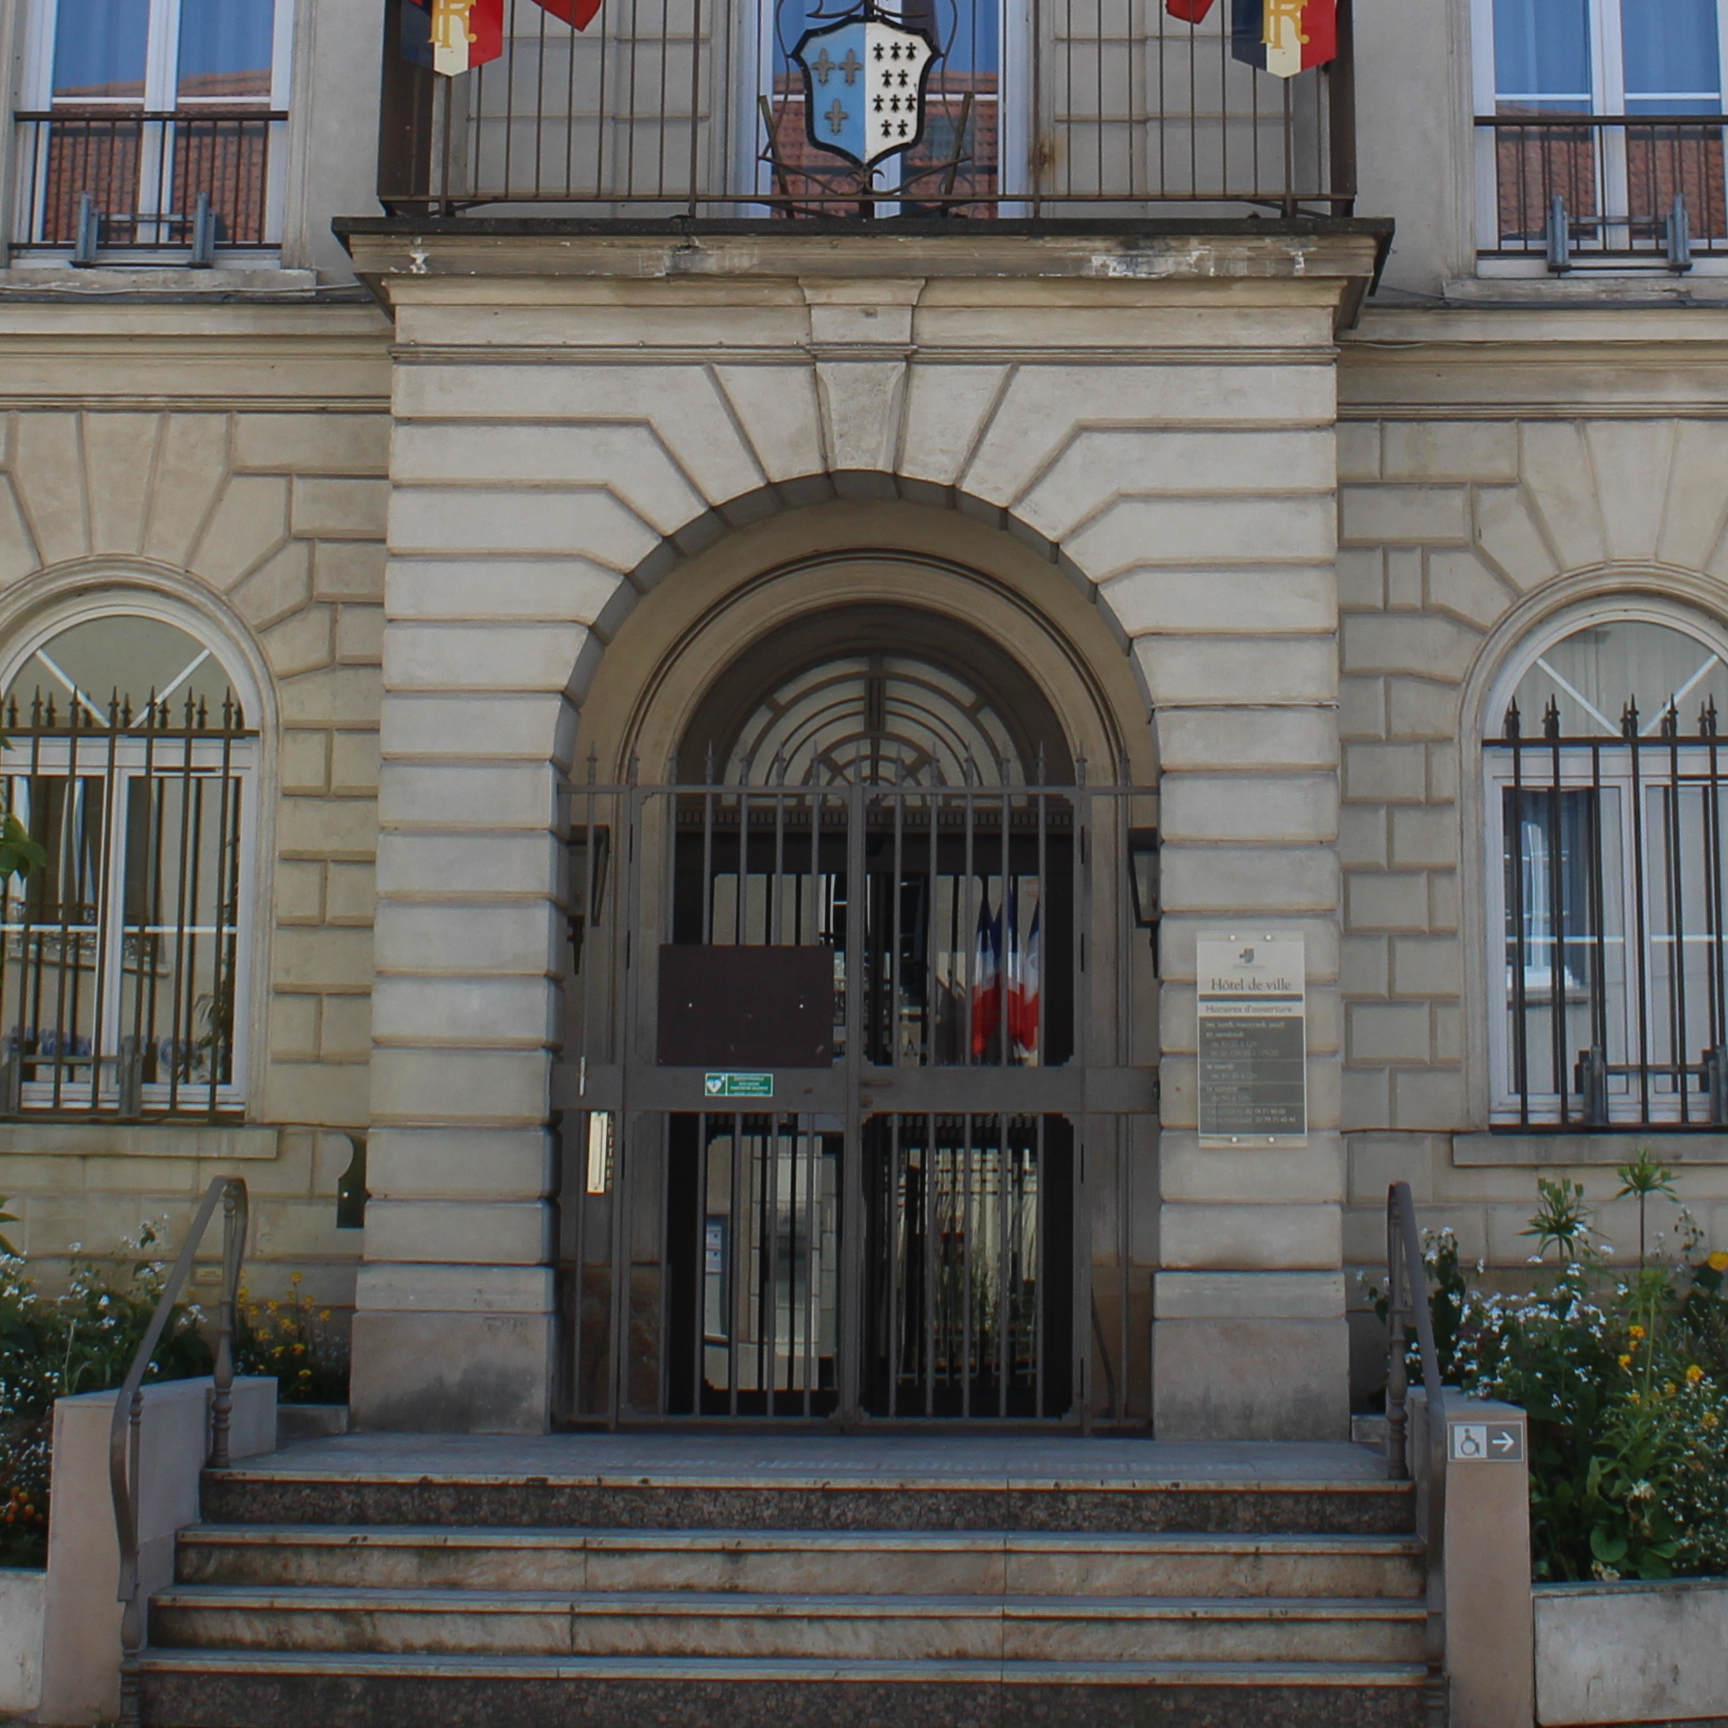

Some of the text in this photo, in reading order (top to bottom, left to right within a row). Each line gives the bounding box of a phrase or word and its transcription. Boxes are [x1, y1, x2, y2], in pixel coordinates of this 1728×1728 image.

[1211, 977, 1291, 990] Hôtel de ville
